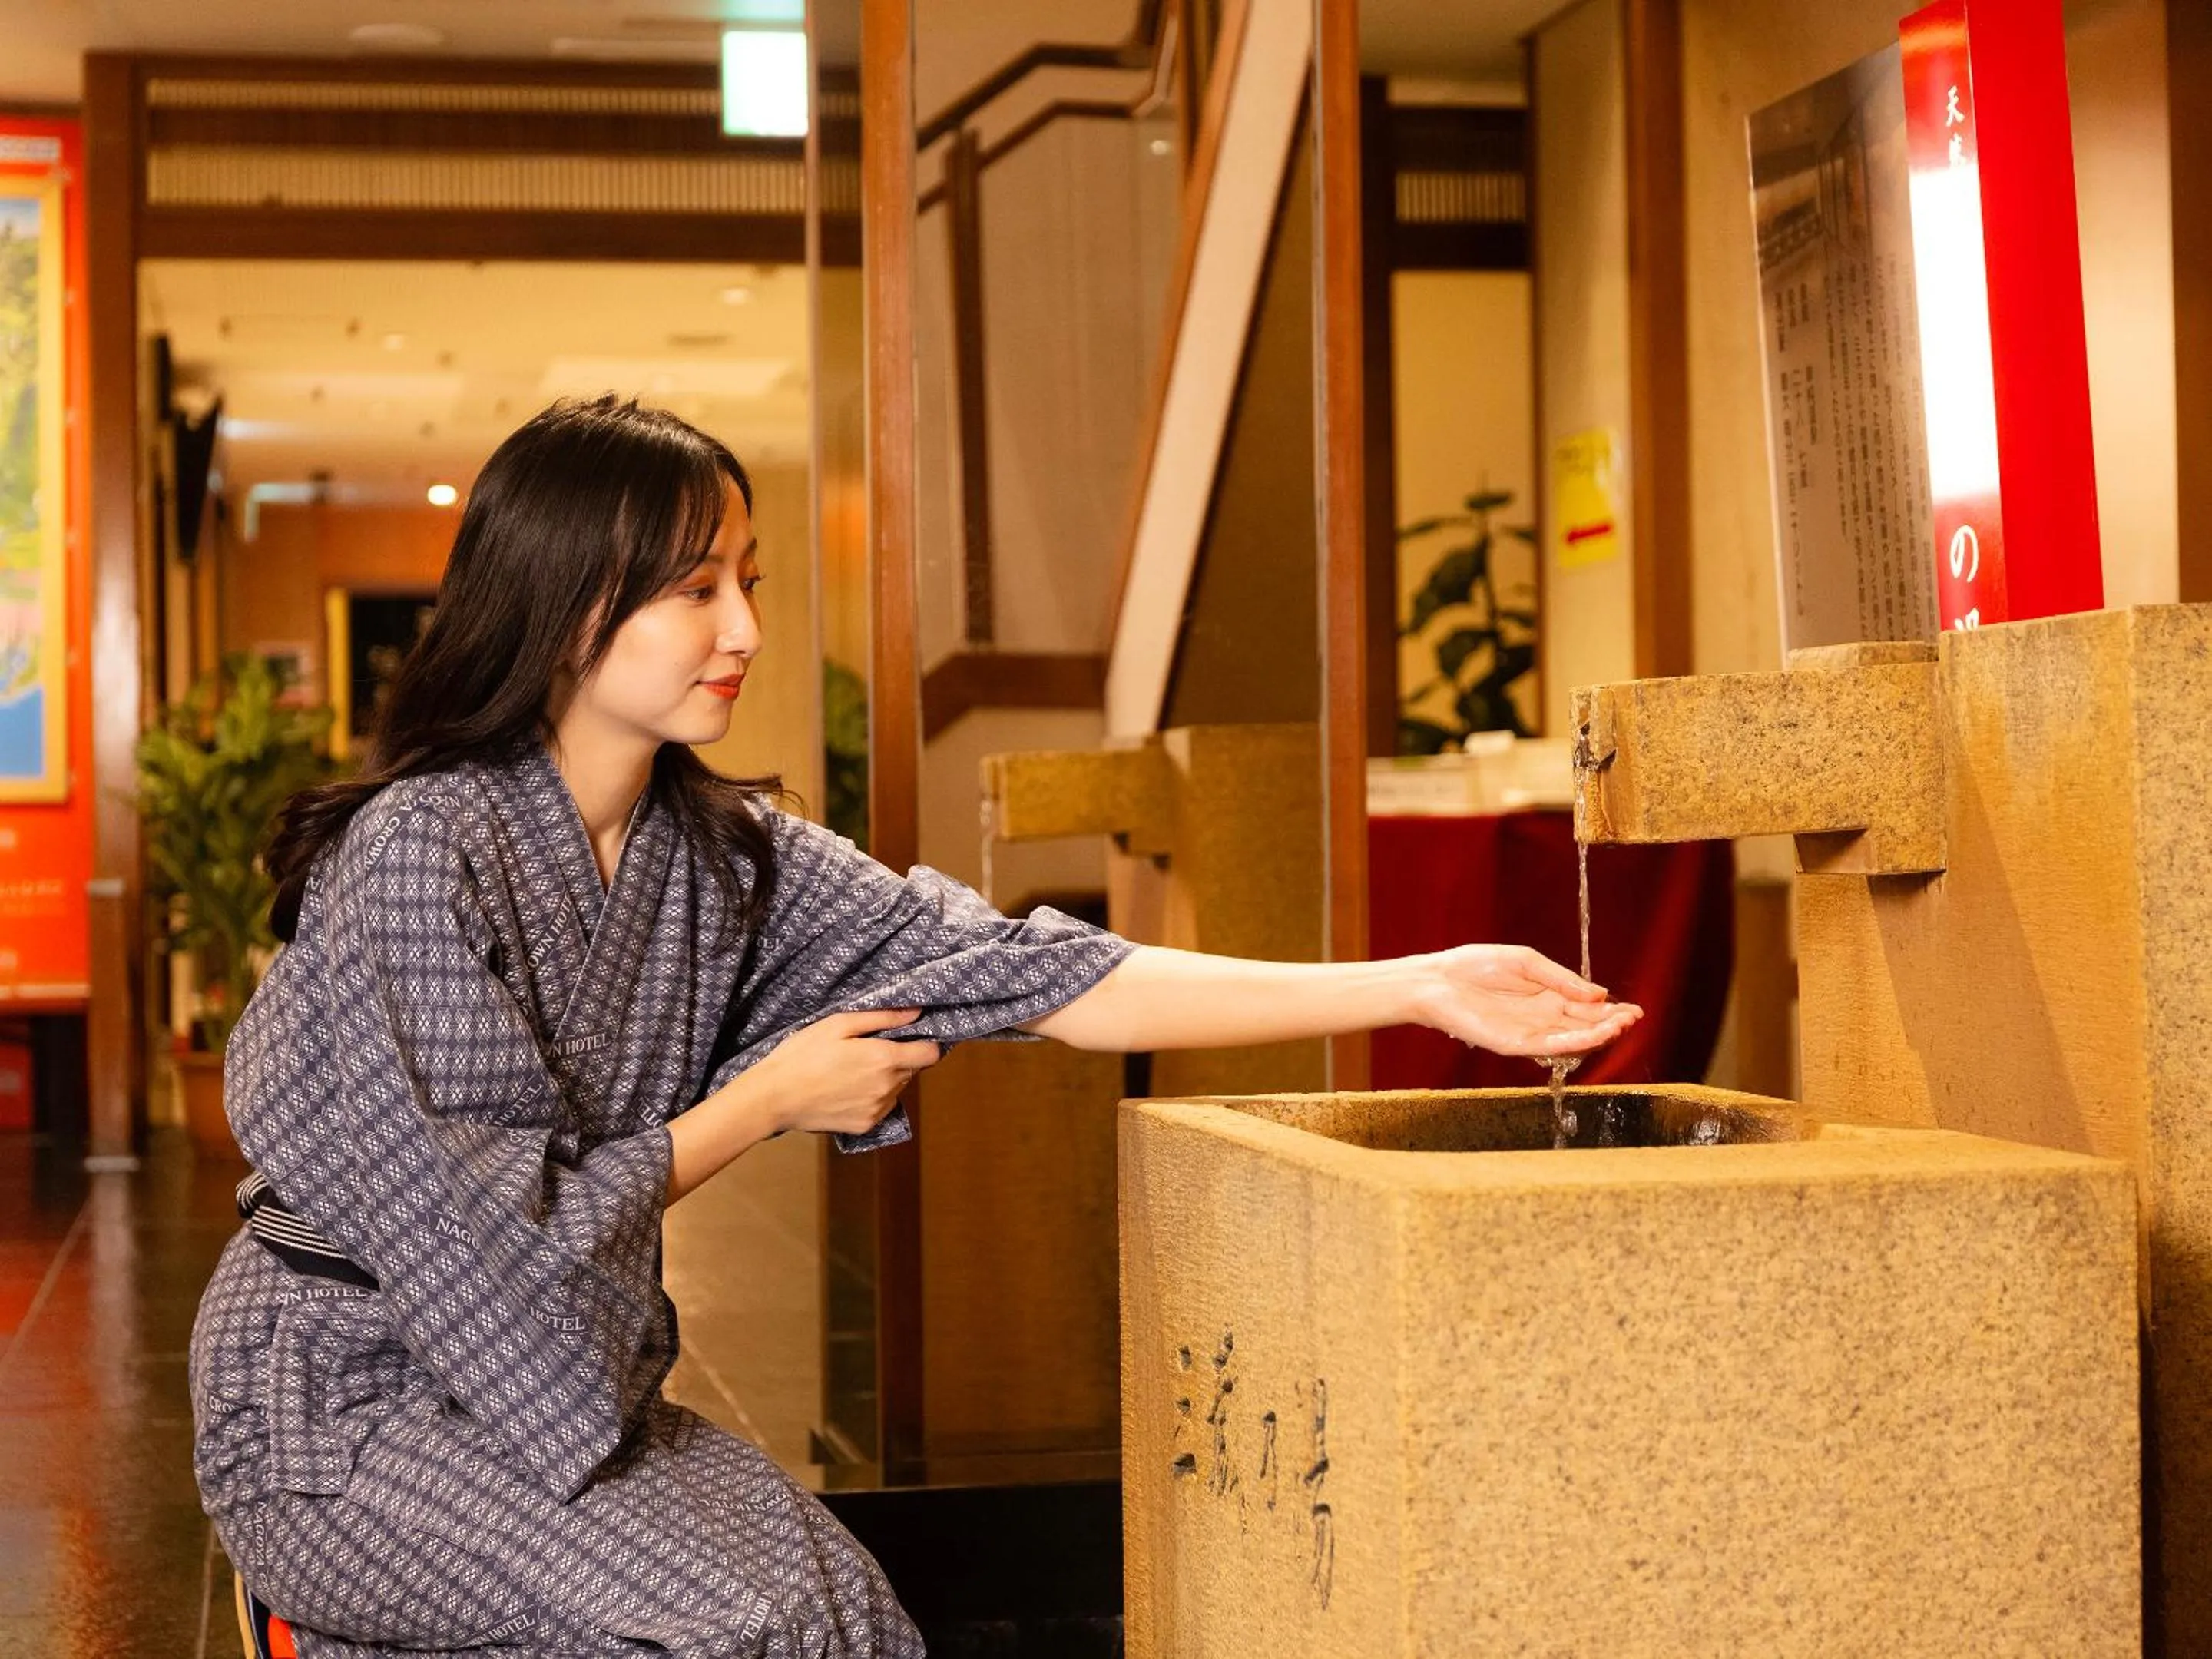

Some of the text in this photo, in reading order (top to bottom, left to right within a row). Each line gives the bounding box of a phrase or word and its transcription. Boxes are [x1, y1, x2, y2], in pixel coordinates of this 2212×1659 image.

[527, 933, 555, 969] OWN
[565, 1033, 611, 1055] HOTEL
[306, 1287, 368, 1300] HOTEL
[530, 1306, 586, 1331] HOTEL
[209, 1394, 233, 1413] CRO
